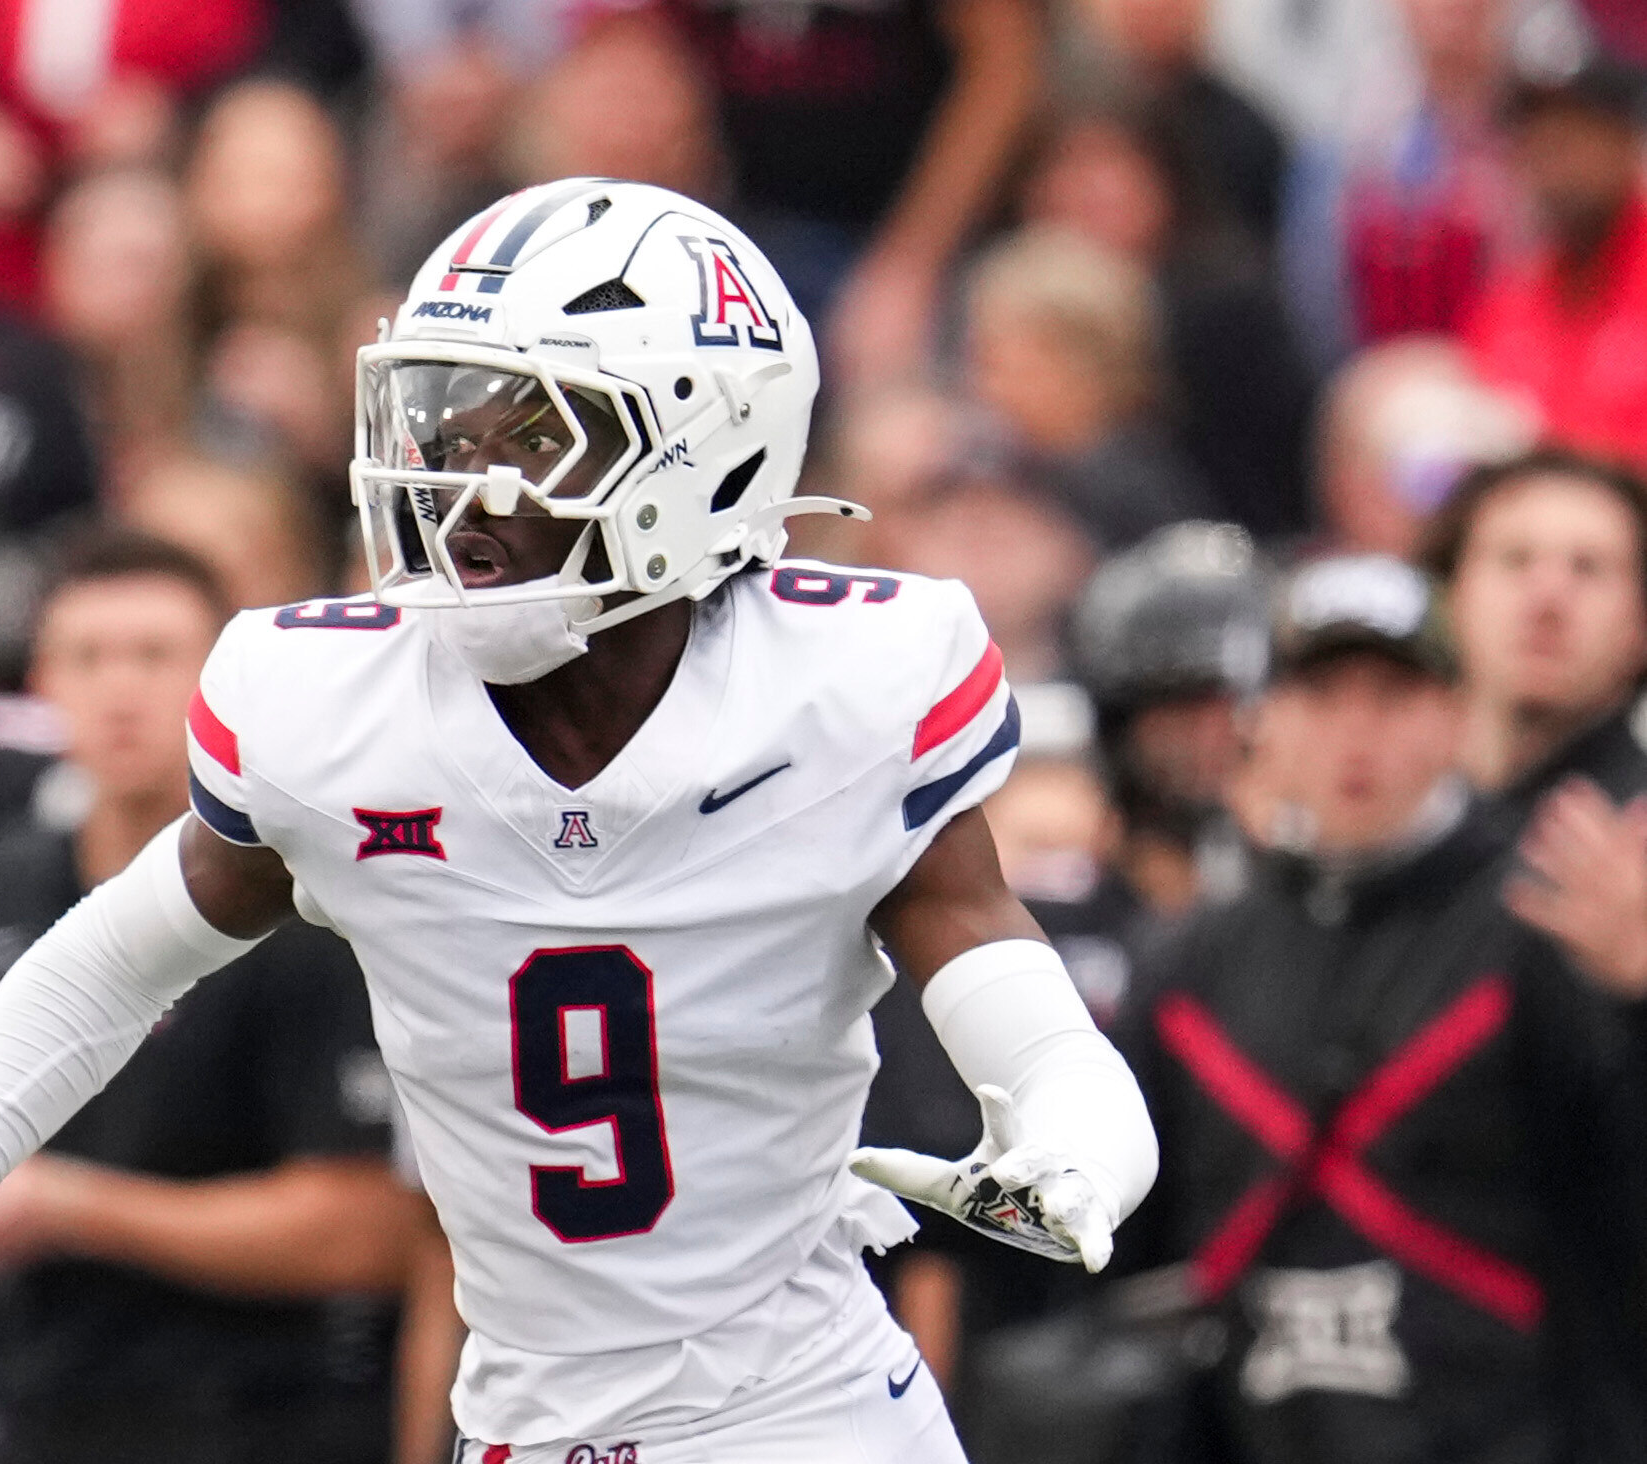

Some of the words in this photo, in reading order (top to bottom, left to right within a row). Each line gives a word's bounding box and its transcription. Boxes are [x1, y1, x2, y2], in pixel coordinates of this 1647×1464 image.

[412, 301, 494, 324] ARIZONA
[676, 235, 784, 352] A
[554, 809, 599, 849] A
[508, 941, 675, 1246] 9
